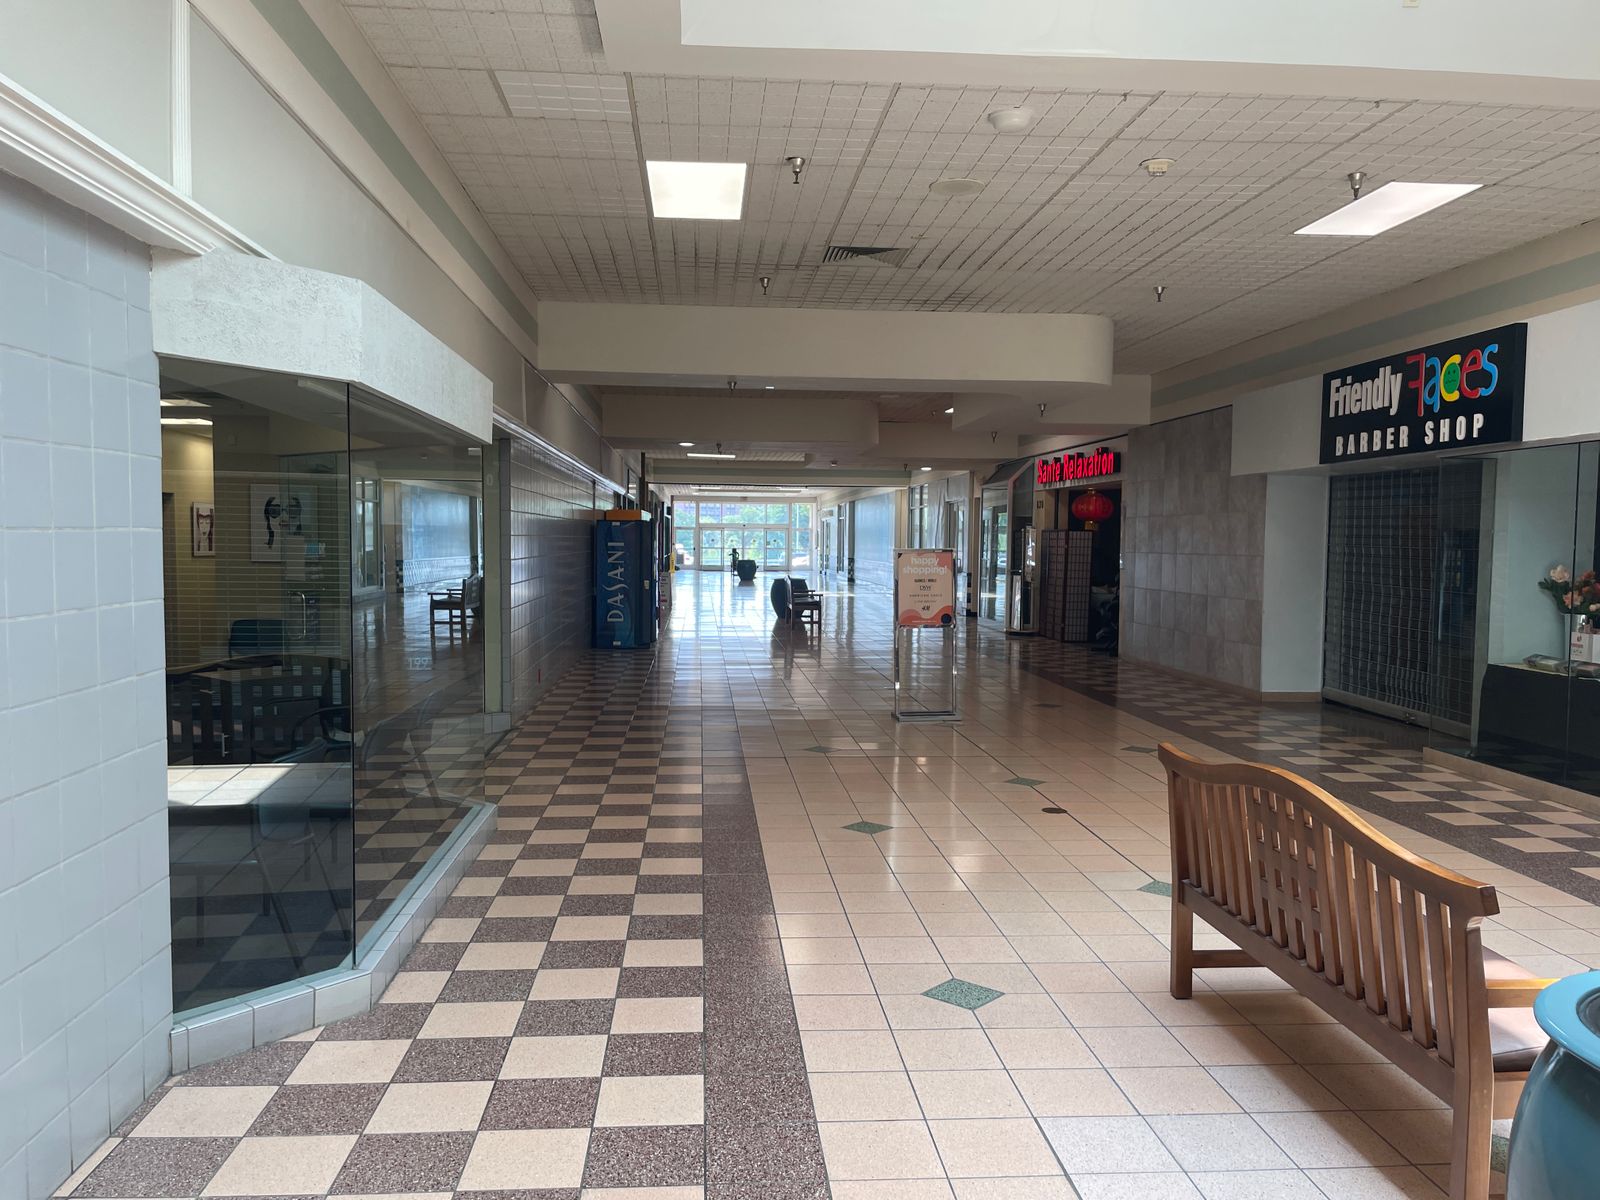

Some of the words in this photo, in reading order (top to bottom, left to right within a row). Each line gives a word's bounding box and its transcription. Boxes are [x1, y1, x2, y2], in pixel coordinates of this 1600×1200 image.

[1329, 365, 1403, 418] Friendly
[1405, 343, 1499, 417] Faces
[1335, 425, 1409, 456] BARBER
[1424, 413, 1485, 445] SHOP
[1037, 457, 1061, 484] Sante
[1063, 447, 1115, 480] Relaxation
[602, 541, 629, 623] DASANI
[911, 556, 939, 566] happy
